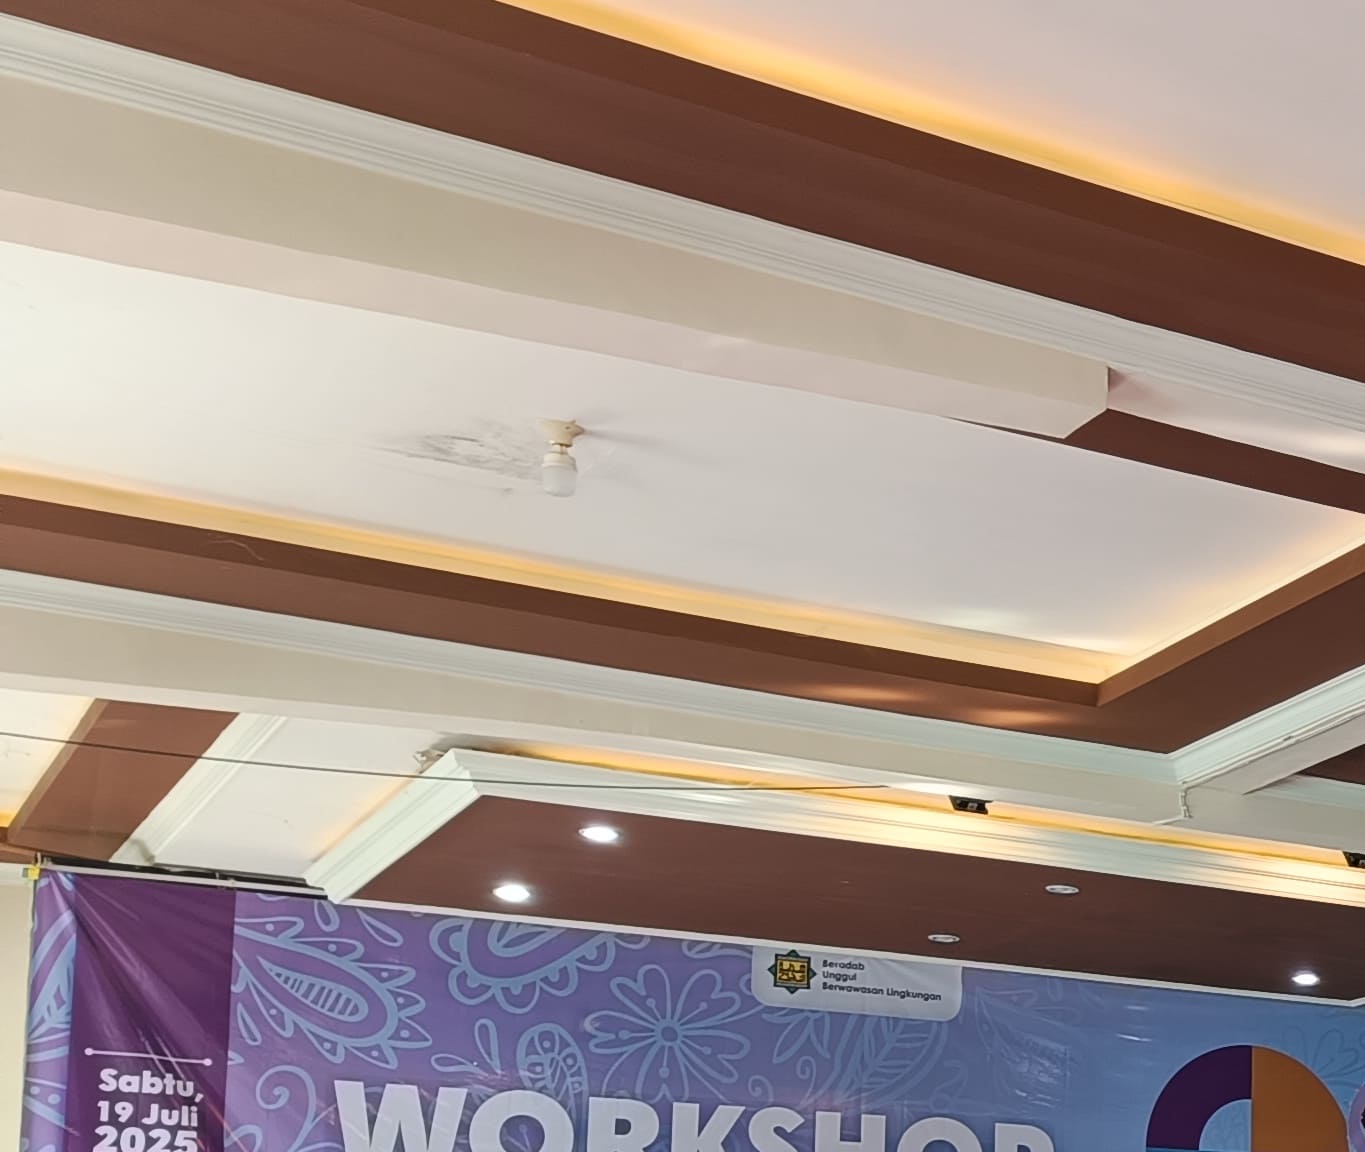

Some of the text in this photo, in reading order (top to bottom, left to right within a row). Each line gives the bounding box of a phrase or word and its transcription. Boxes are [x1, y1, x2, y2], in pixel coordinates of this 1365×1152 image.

[822, 959, 865, 970] Beradab
[822, 971, 857, 982] Unggul
[822, 982, 942, 1001] Berwawasan Lingkungan
[98, 1068, 204, 1103] Sabtu,
[97, 1101, 198, 1127] 19 Juli
